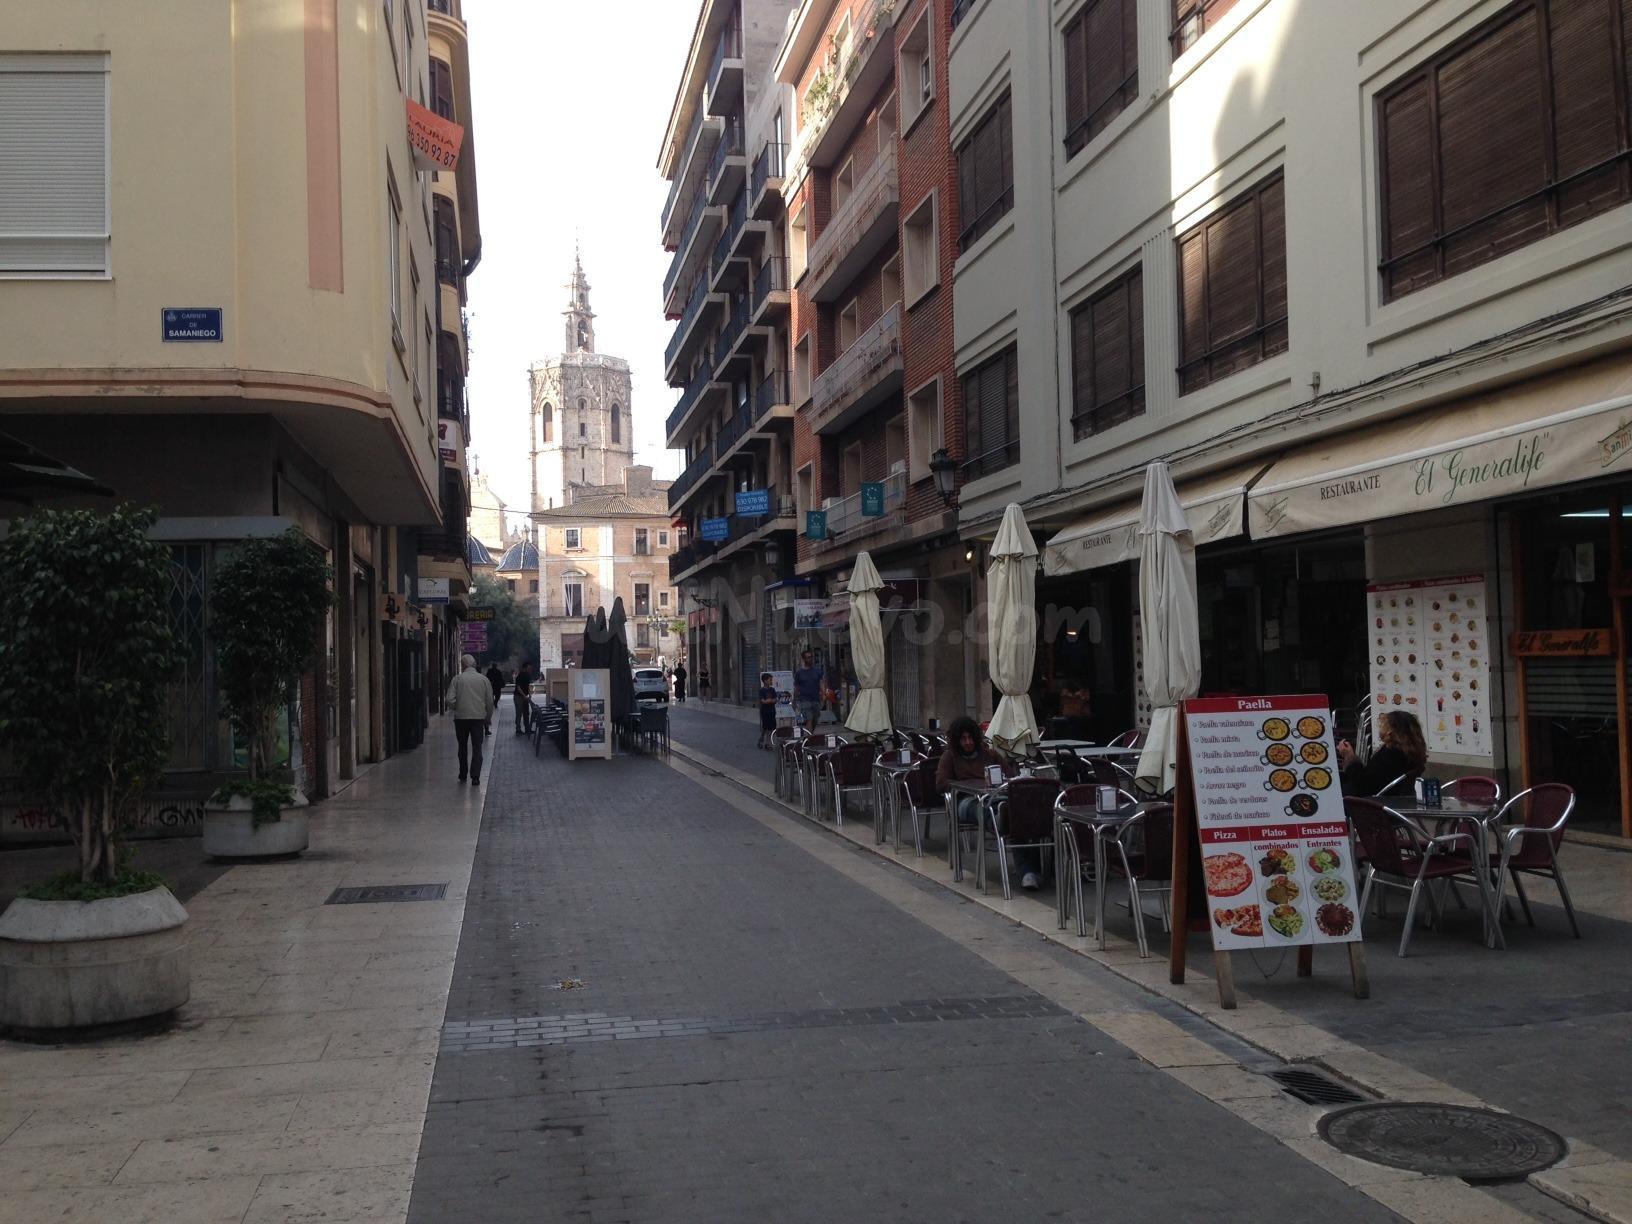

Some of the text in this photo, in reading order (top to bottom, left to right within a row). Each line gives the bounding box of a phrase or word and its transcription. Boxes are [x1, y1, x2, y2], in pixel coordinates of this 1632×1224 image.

[431, 143, 442, 162] 92
[443, 151, 456, 168] 87
[168, 329, 217, 337] SAMANIEGO
[1320, 474, 1382, 501] RESTAURANTE
[1083, 534, 1113, 550] RESTAURANTE
[1237, 699, 1272, 710] Paella
[1213, 824, 1344, 840] Pizza Platos Ensaladas
[1253, 839, 1342, 851] combinados Entrantes
